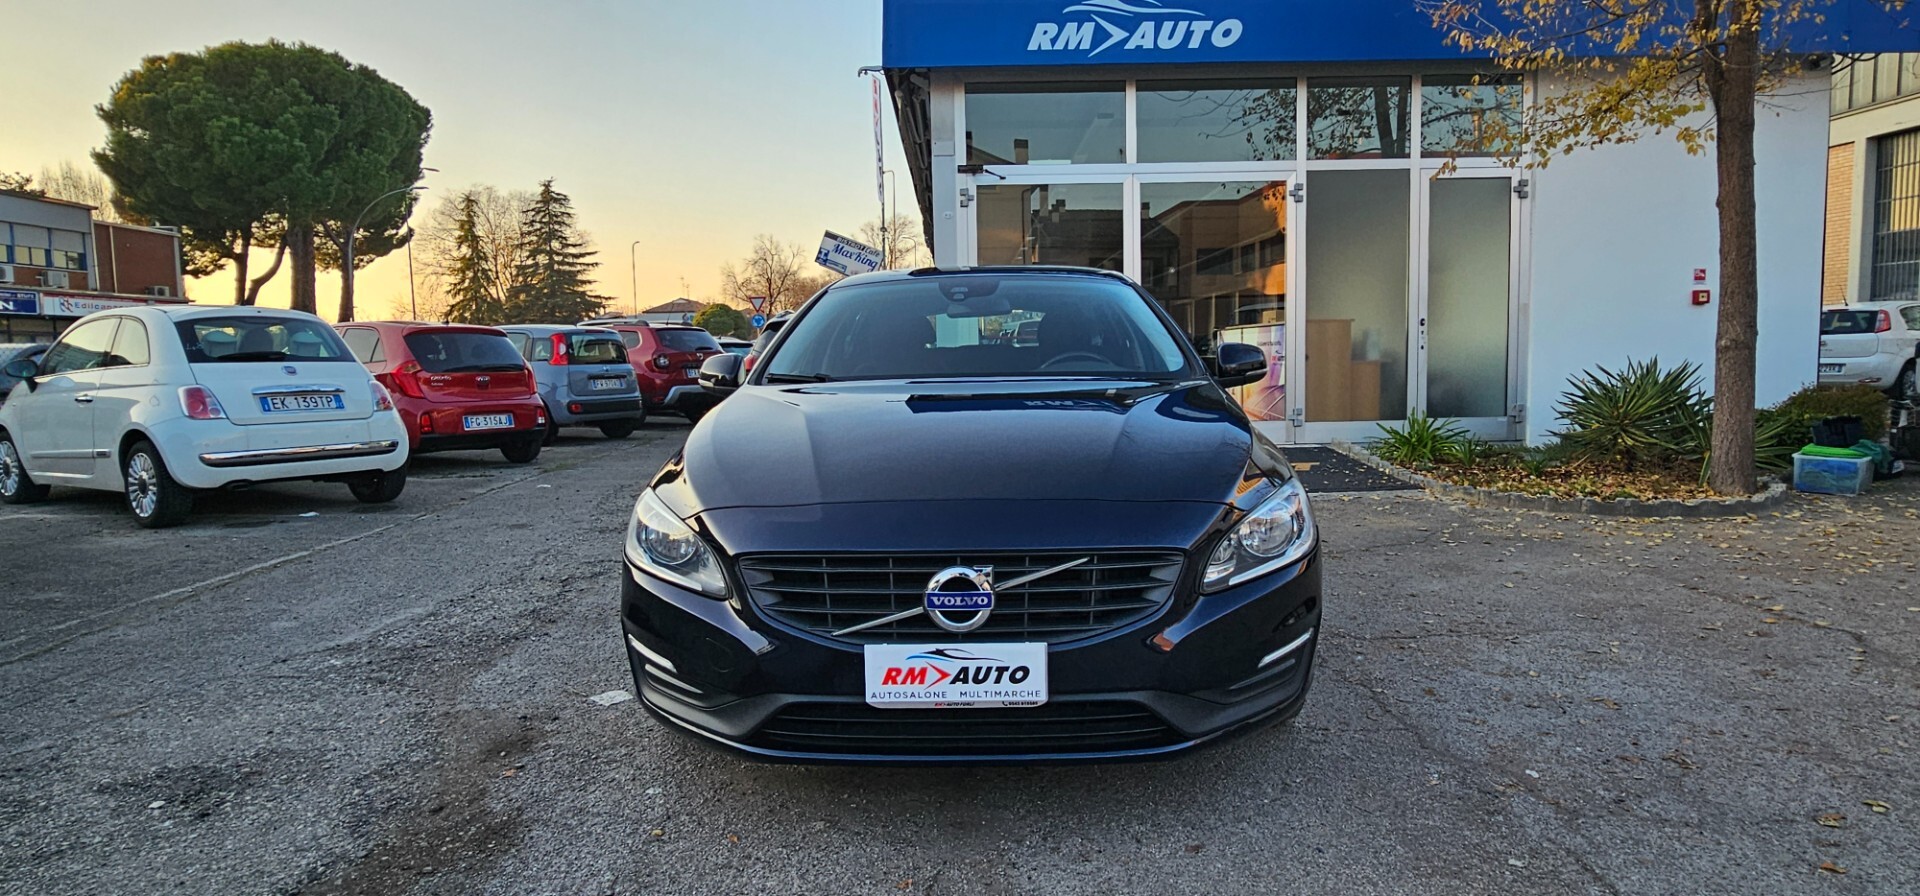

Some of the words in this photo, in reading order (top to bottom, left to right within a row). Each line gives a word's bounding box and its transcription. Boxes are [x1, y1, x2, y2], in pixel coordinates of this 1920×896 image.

[1027, 22, 1096, 51] RM
[1123, 18, 1243, 50] AUTO
[271, 397, 289, 410] EK
[294, 396, 333, 408] 139TP
[483, 416, 508, 426] 315AJ
[930, 596, 989, 606] VOLVO
[881, 666, 928, 686] RM
[949, 665, 1030, 685] AUTO
[871, 691, 948, 699] AUTOSALONE
[959, 690, 1041, 699] MULTIMARCHE
